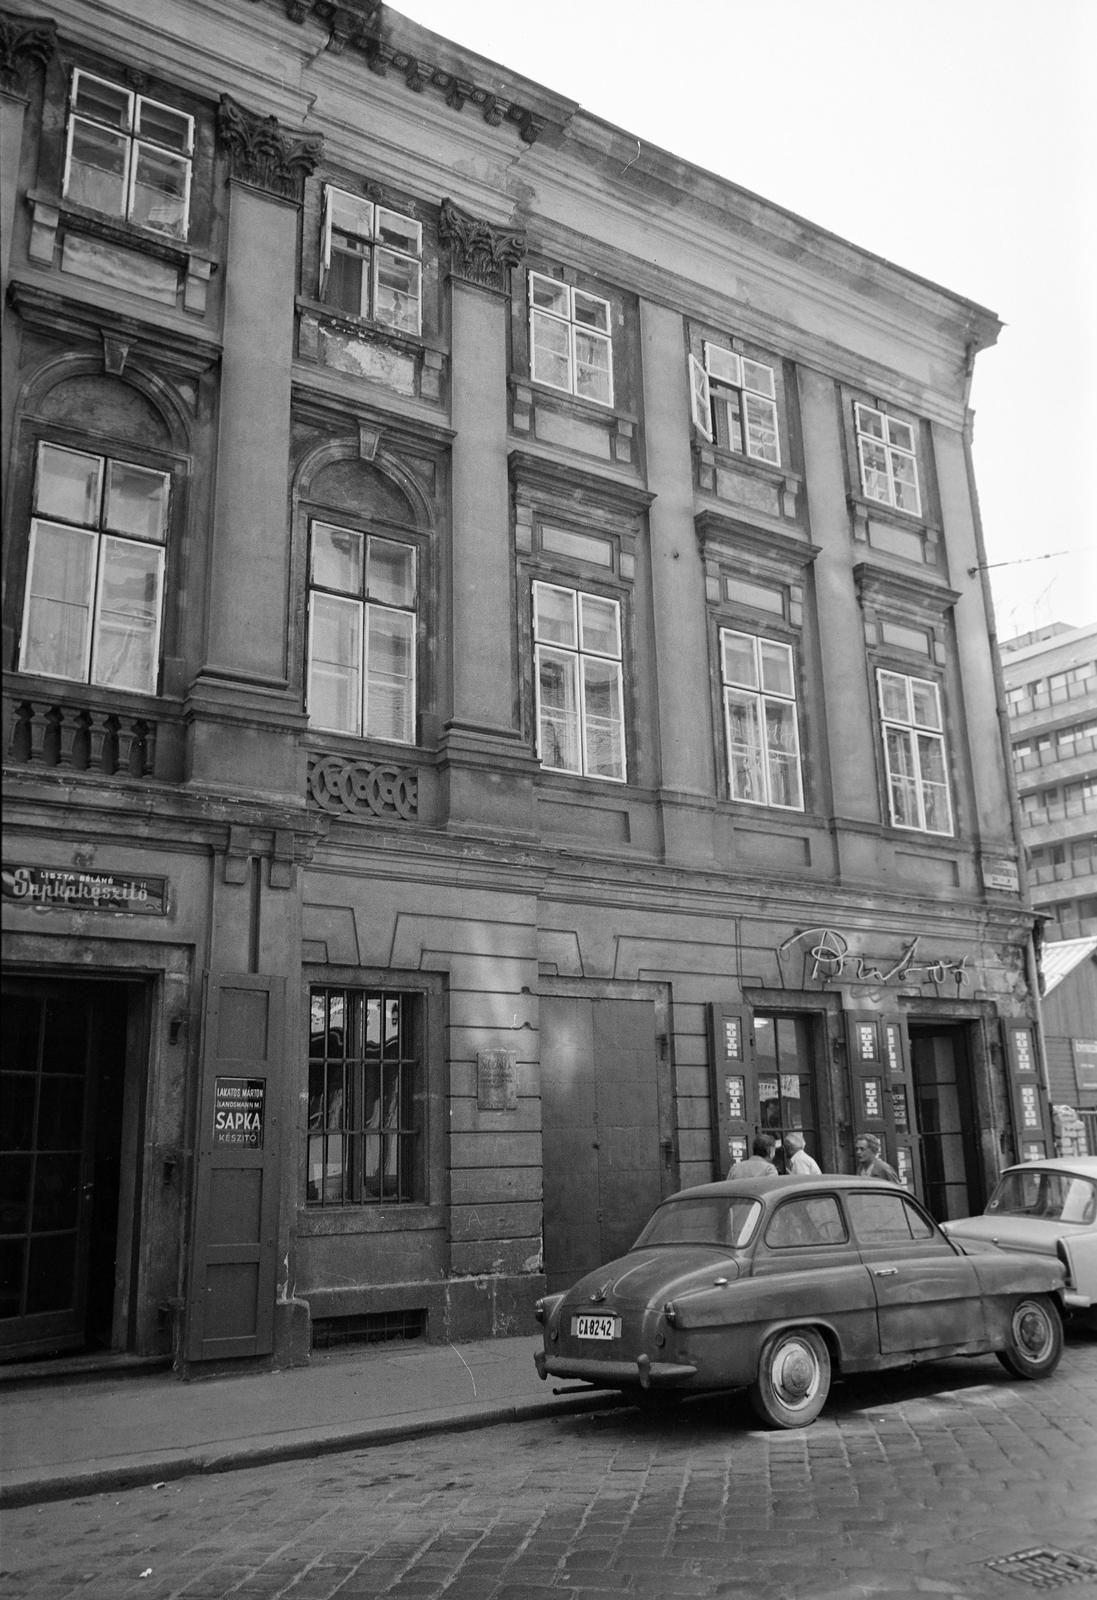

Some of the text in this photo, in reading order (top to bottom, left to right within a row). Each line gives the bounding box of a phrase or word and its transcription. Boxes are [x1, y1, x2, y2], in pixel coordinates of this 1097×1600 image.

[216, 1086, 264, 1098] LAKATOS MÁRTON
[215, 1111, 261, 1130] SAPKA
